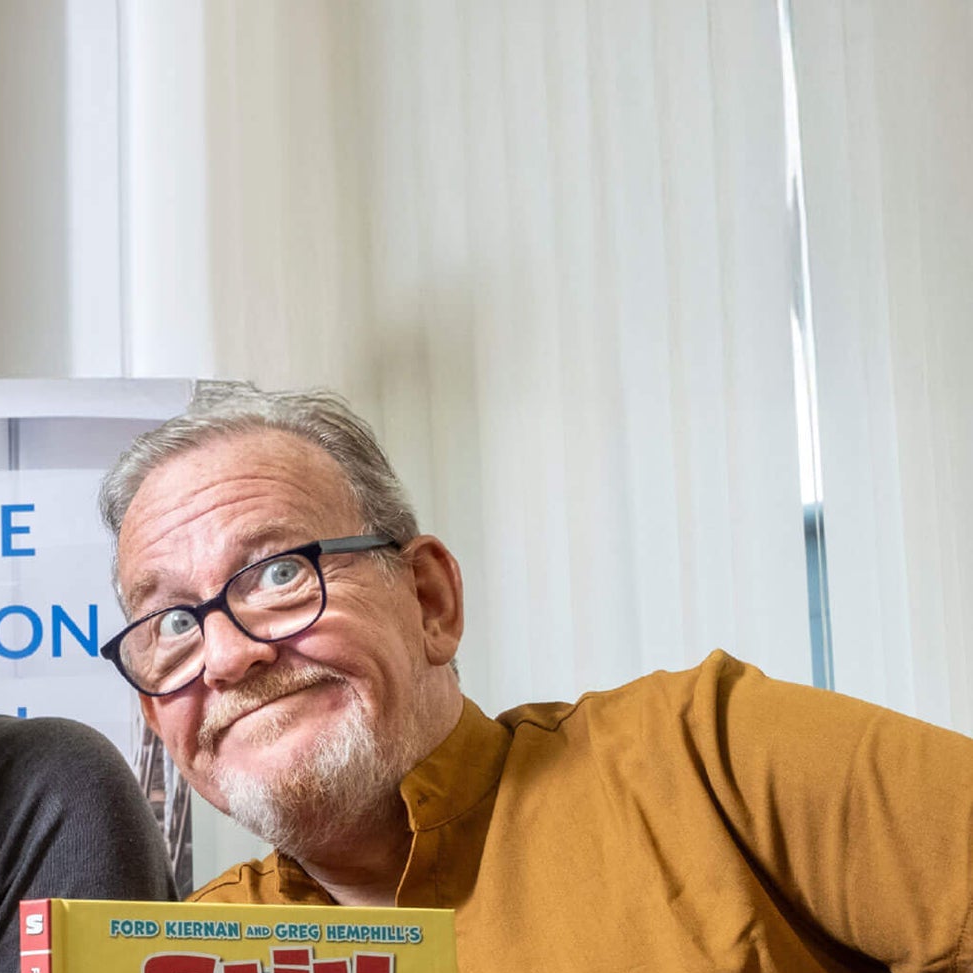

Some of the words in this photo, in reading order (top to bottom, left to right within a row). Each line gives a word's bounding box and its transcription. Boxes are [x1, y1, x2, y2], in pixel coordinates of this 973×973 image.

[25, 914, 44, 935] S
[110, 920, 159, 937] FORD
[165, 921, 240, 938] KIERNAN
[246, 926, 270, 937] AND
[274, 923, 320, 940] GREG
[327, 925, 422, 942] HEMPHILL'S
